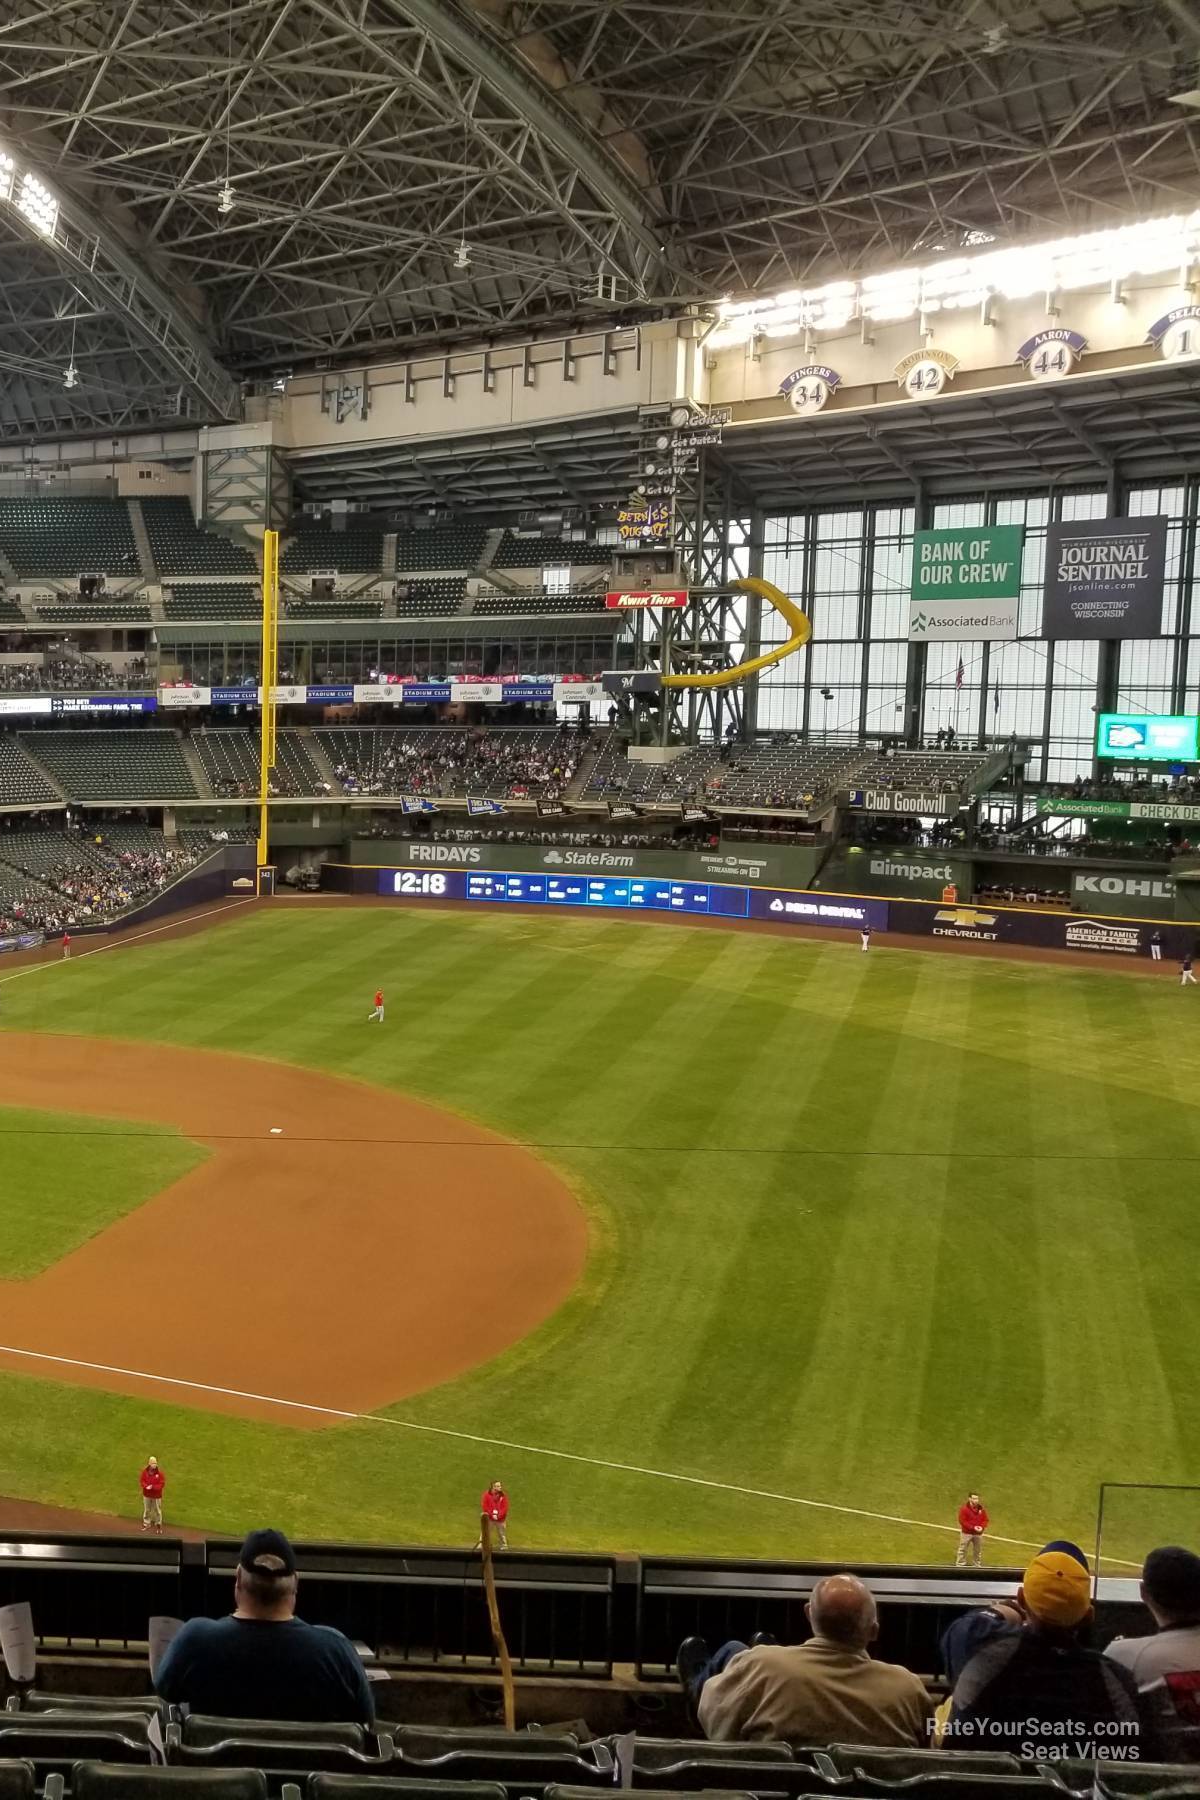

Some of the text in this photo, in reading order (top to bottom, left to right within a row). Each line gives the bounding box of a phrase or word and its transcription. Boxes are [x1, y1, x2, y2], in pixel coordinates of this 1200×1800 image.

[1034, 331, 1072, 346] AARON
[1178, 329, 1192, 354] 1
[902, 353, 950, 369] ROBINSON
[1034, 348, 1065, 373] 44
[790, 367, 832, 383] FINGERS
[910, 368, 940, 391] 42
[796, 384, 823, 407] 34
[671, 439, 688, 448] Get
[674, 448, 697, 456] Here
[658, 466, 686, 476] Get Up
[620, 522, 669, 539] DUGOUT
[921, 540, 991, 563] BANK OF
[1058, 544, 1150, 566] JOURNAL
[920, 565, 953, 585] OUR
[1058, 562, 1149, 582] SENTINEL
[1068, 582, 1136, 593] jsonline.com
[618, 594, 676, 606] KWIK TRIP
[1071, 601, 1130, 610] CONNECTING
[1074, 610, 1125, 619] WISCONSIN
[866, 790, 946, 814] Club Goodwill
[1140, 804, 1180, 819] CHECK
[409, 845, 481, 863] FRIDAYS
[886, 859, 953, 880] impact
[394, 872, 447, 895] 12:18
[1076, 876, 1176, 898] KOHL'
[932, 927, 999, 941] CHEVROLET
[1067, 927, 1138, 939] AMERICAN FAMILY
[1072, 935, 1131, 944] INSURANCE
